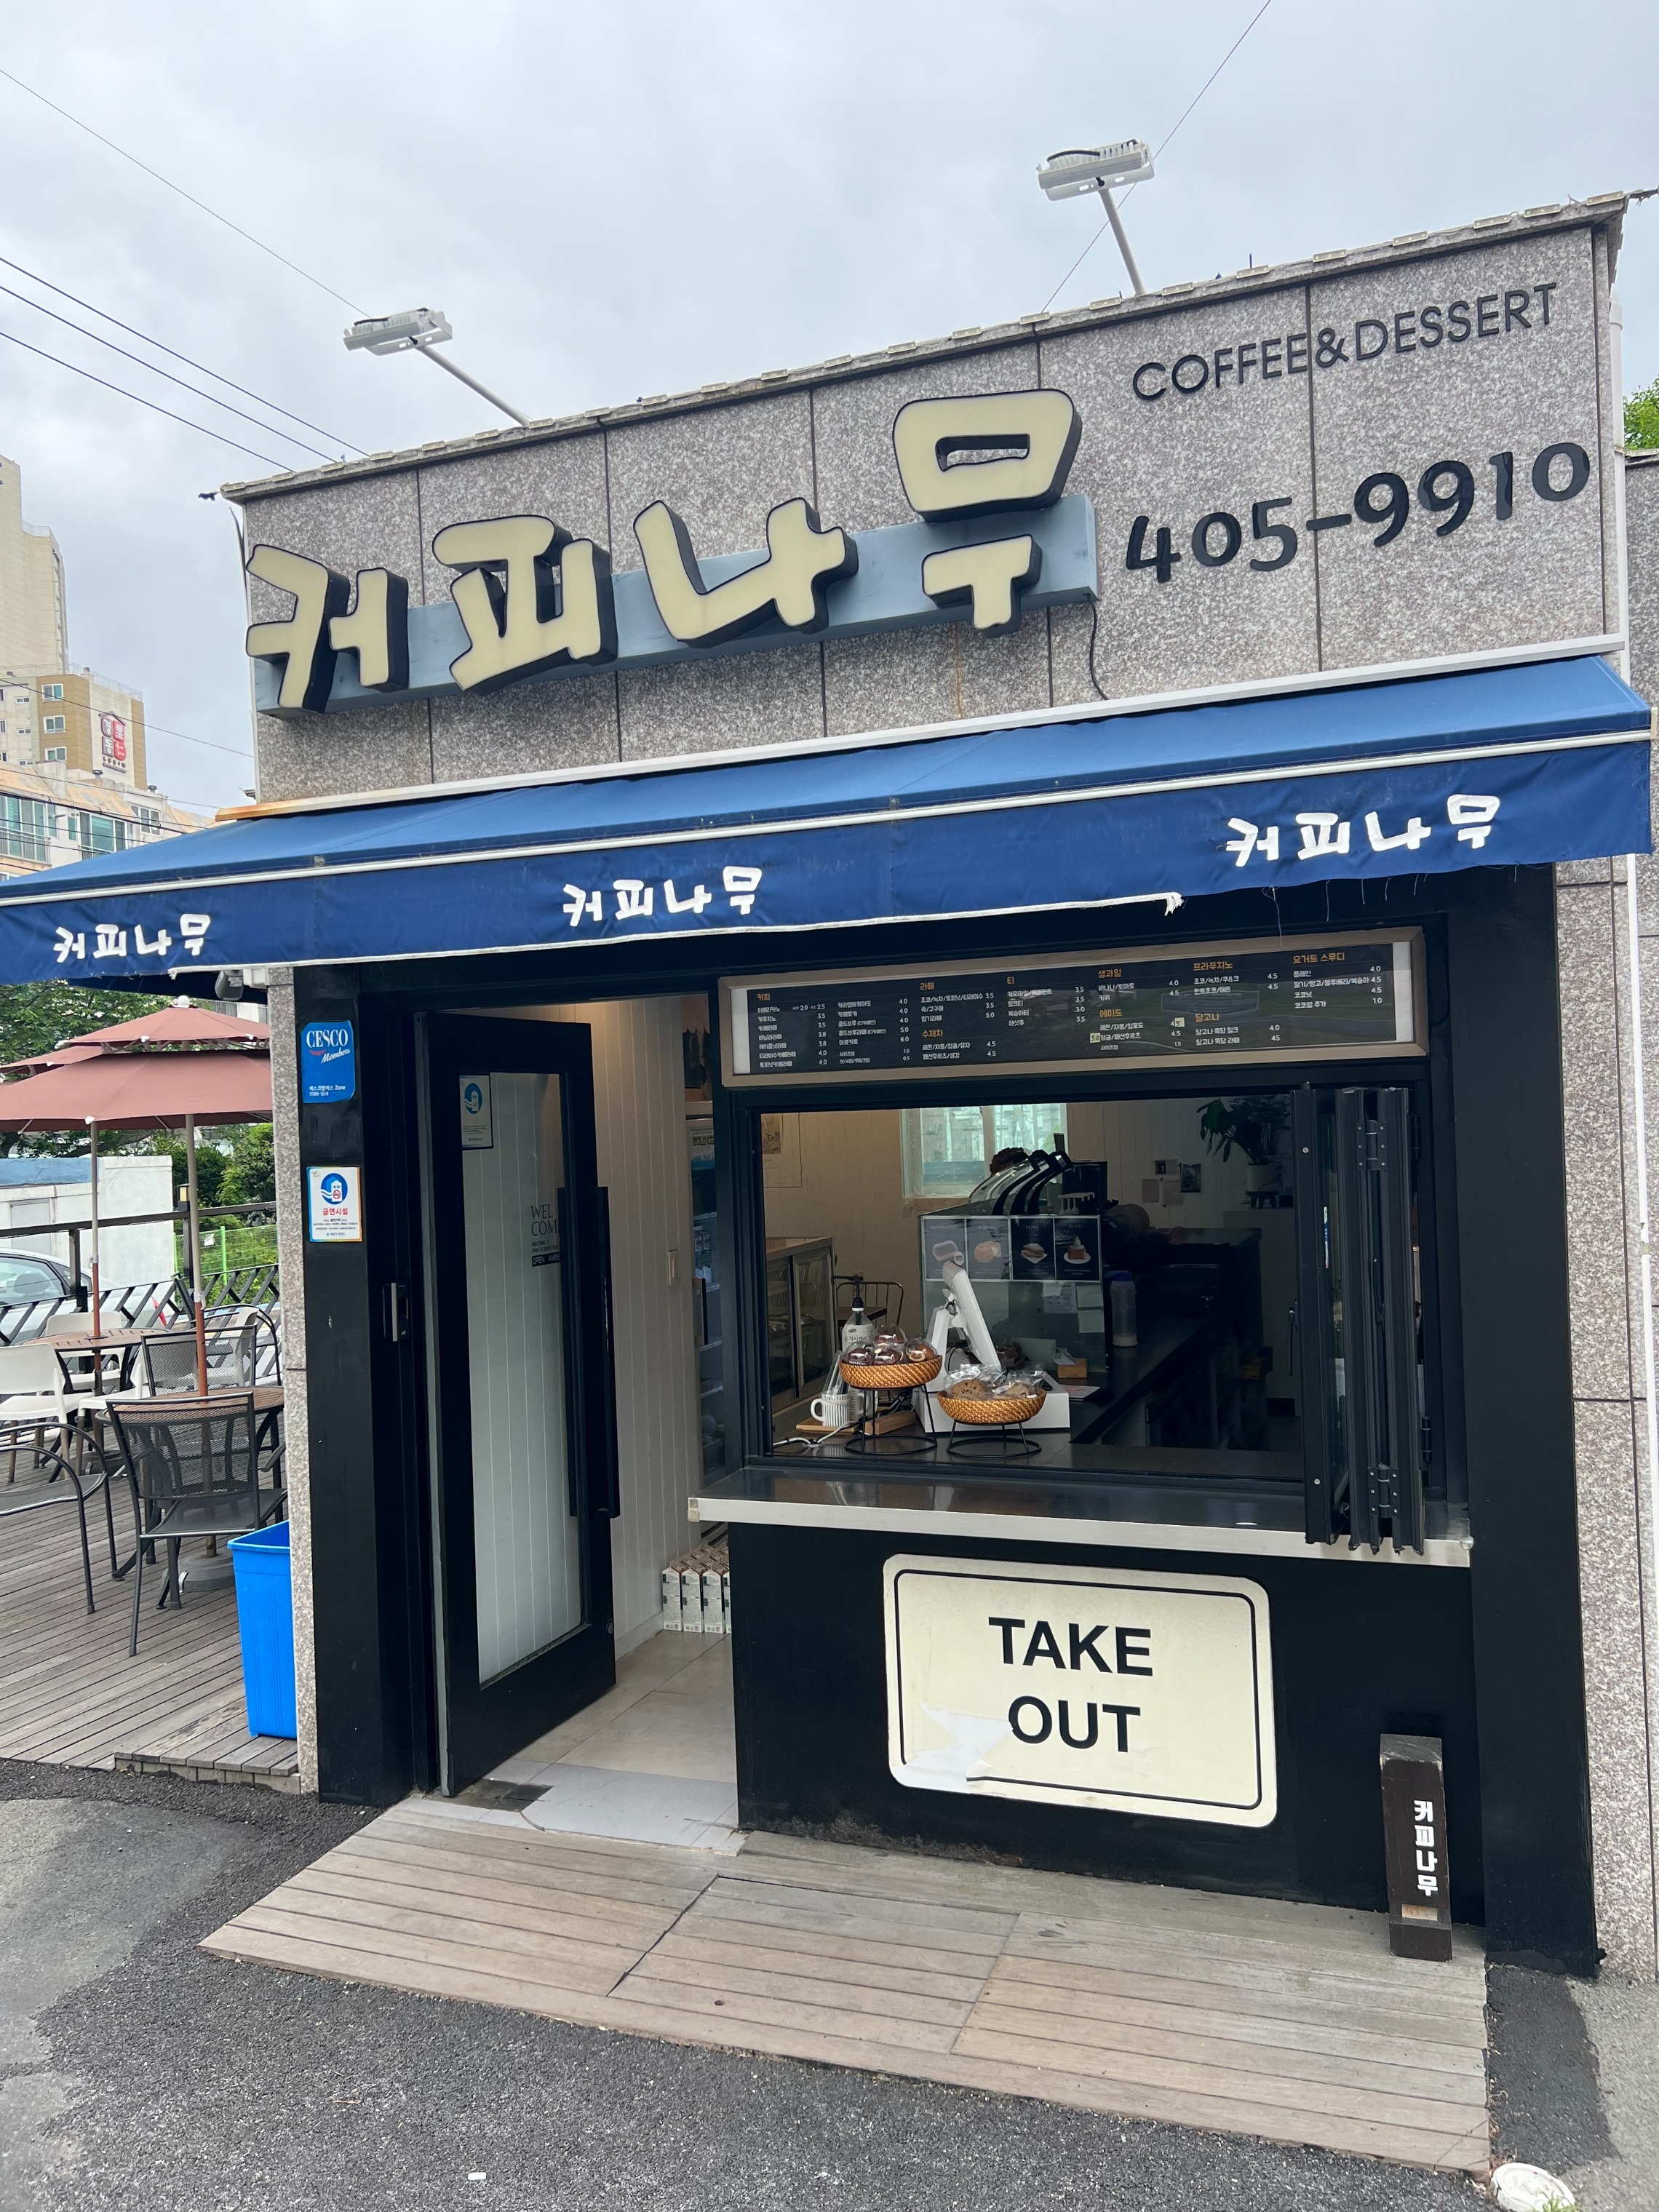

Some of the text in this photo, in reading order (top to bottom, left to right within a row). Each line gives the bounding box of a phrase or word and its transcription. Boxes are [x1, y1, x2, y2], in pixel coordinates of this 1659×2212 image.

[1132, 282, 1556, 400] COFFEE&DESSERT
[1126, 442, 1591, 583] 405-9910
[246, 388, 1082, 714] 커피나무
[1226, 794, 1500, 867] 커피나무
[562, 867, 762, 926] 커피나무
[53, 914, 211, 962] 커피나무
[1193, 961, 1233, 971] 프라푸치노
[1293, 952, 1345, 964] 요거트 스무디
[1007, 976, 1014, 984] 티
[1098, 969, 1122, 978] 생과일
[920, 982, 935, 990] 라떼
[1099, 983, 1135, 991] 바나나/토마토
[757, 993, 771, 1001] 커피
[1100, 1009, 1123, 1018] 에이드
[1195, 1013, 1220, 1022] 달고나
[306, 1029, 349, 1048] CESCO
[923, 1030, 944, 1038] 수제차
[1196, 1038, 1214, 1046] 달고나
[321, 1047, 351, 1064] Members
[323, 1208, 348, 1216] 금연시설
[530, 1204, 553, 1220] WEL
[531, 1220, 560, 1236] COM
[989, 1617, 1153, 1676] TAKE
[1008, 1695, 1140, 1752] OUT
[1414, 1800, 1438, 1896] 커피나무
